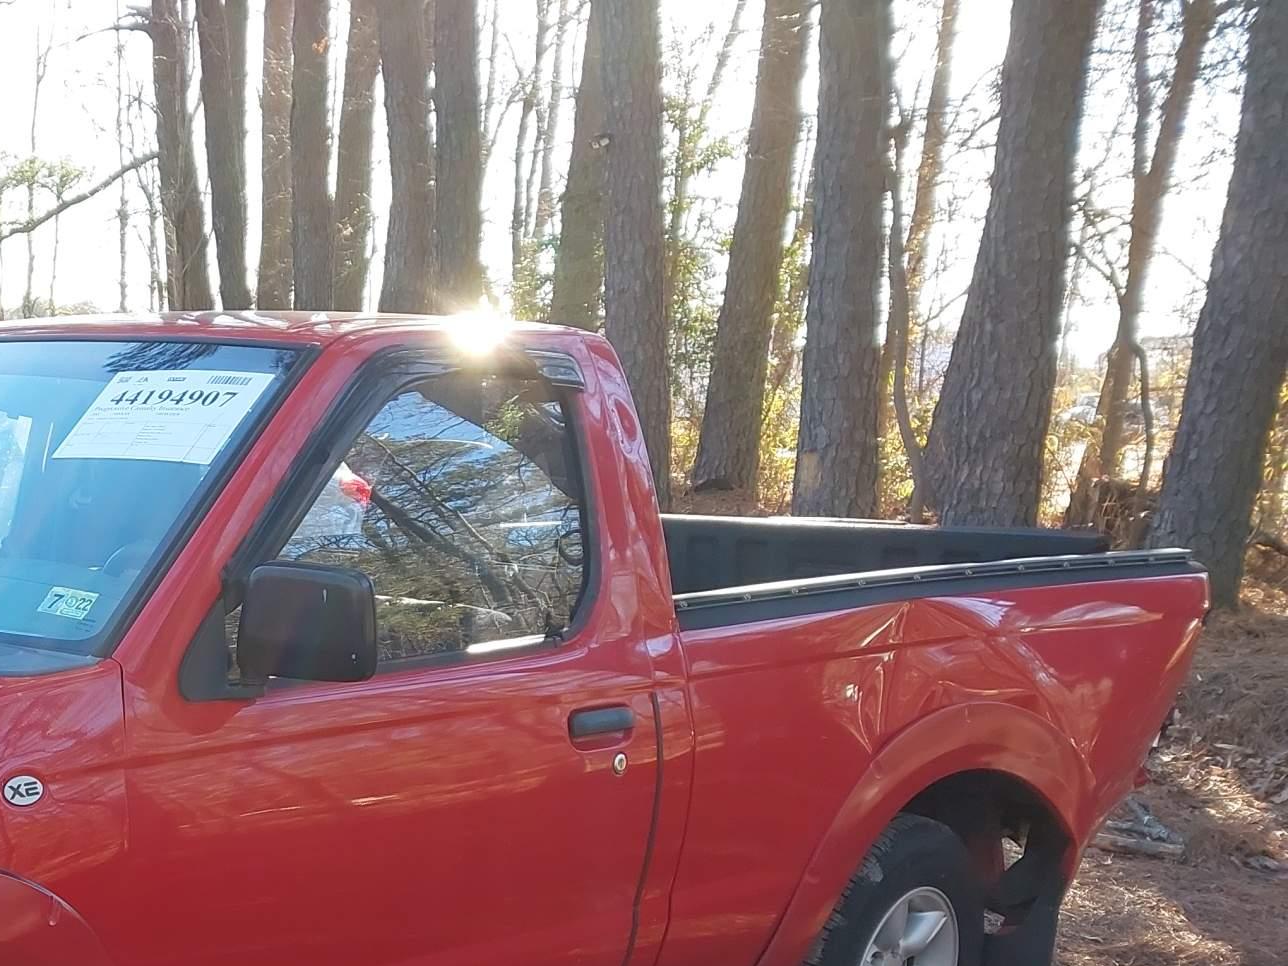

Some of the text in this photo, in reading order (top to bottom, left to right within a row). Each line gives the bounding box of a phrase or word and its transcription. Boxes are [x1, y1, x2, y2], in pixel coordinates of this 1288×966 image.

[110, 389, 240, 408] 44194907
[47, 593, 92, 611] 7 22
[7, 781, 40, 800] XE
